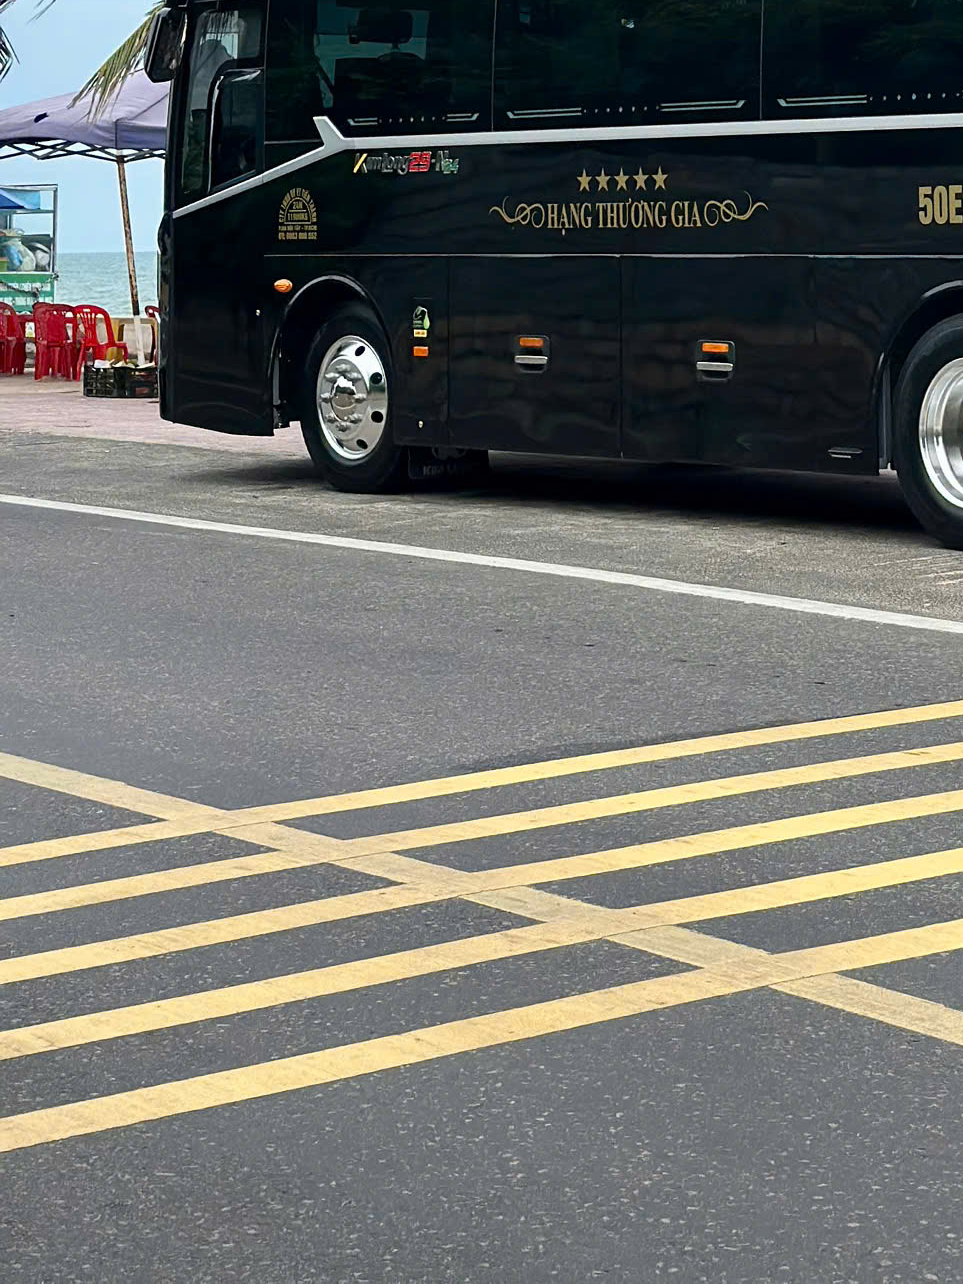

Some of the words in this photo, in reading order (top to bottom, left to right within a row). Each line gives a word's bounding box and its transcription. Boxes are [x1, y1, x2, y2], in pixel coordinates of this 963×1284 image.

[547, 202, 592, 236] HẠNG
[596, 198, 668, 229] THƯƠNG
[670, 200, 702, 228] GIA
